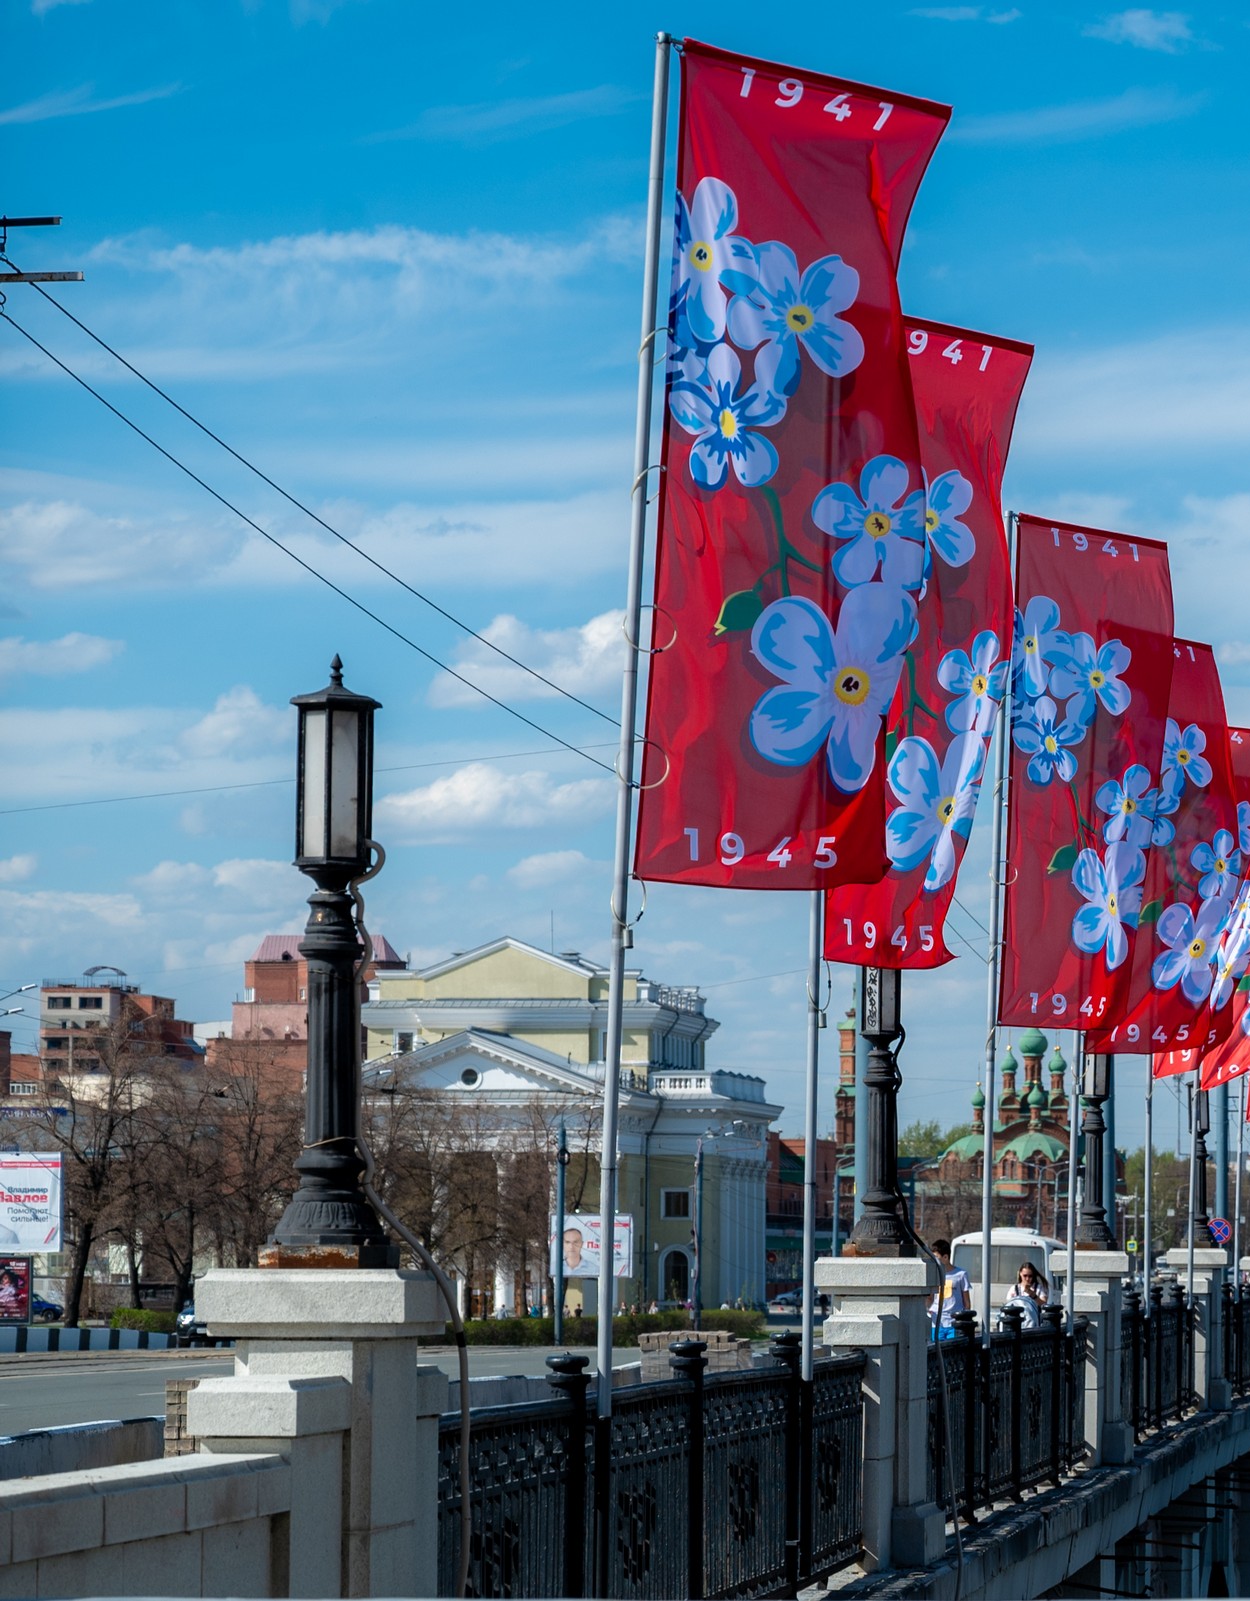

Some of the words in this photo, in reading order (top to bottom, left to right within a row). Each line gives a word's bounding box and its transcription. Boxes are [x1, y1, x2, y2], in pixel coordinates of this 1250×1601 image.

[739, 66, 894, 131] 1941
[1050, 527, 1140, 562] 1941
[683, 827, 838, 869] 1945
[843, 918, 934, 952] 1945
[1029, 992, 1107, 1017] 1945
[1110, 1023, 1190, 1043] 1945
